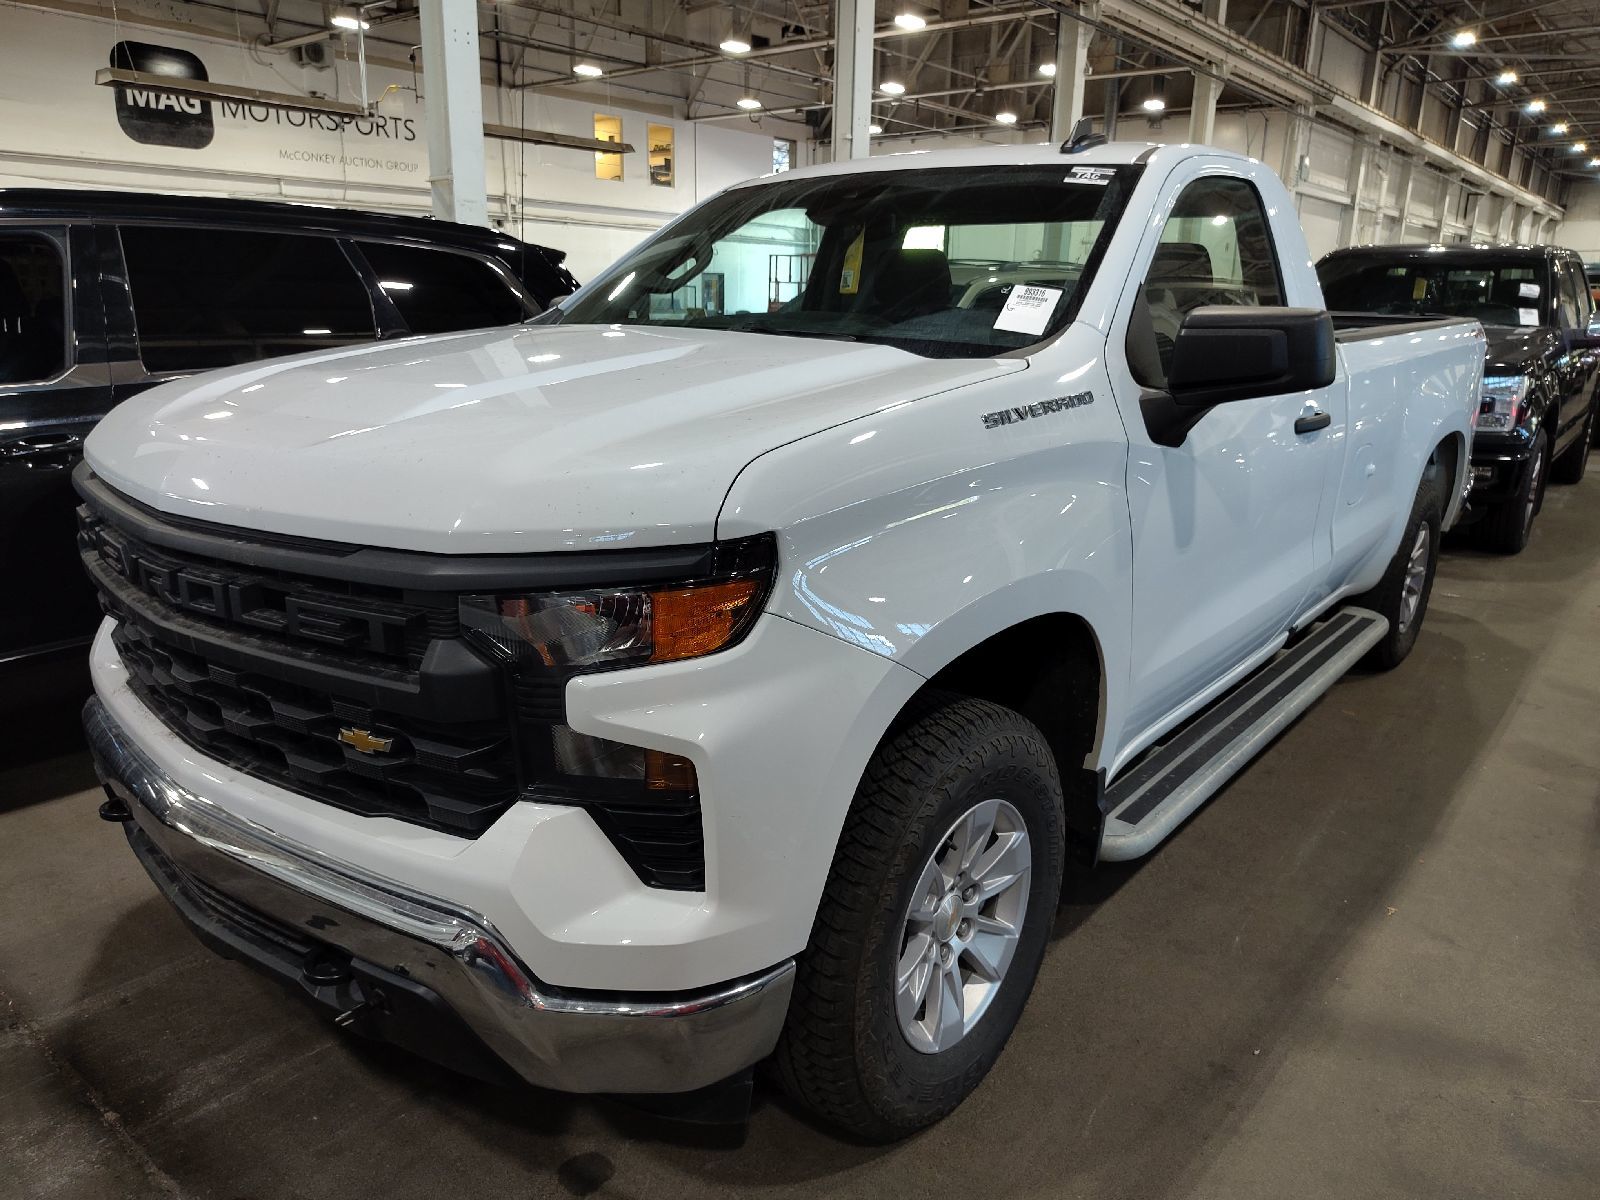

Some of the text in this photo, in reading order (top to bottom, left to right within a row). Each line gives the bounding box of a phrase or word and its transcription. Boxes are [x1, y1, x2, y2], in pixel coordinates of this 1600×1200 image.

[125, 89, 203, 115] MAG
[279, 149, 419, 174] McCONKEY AUCTION GROUP
[981, 390, 1095, 430] SILVERADO
